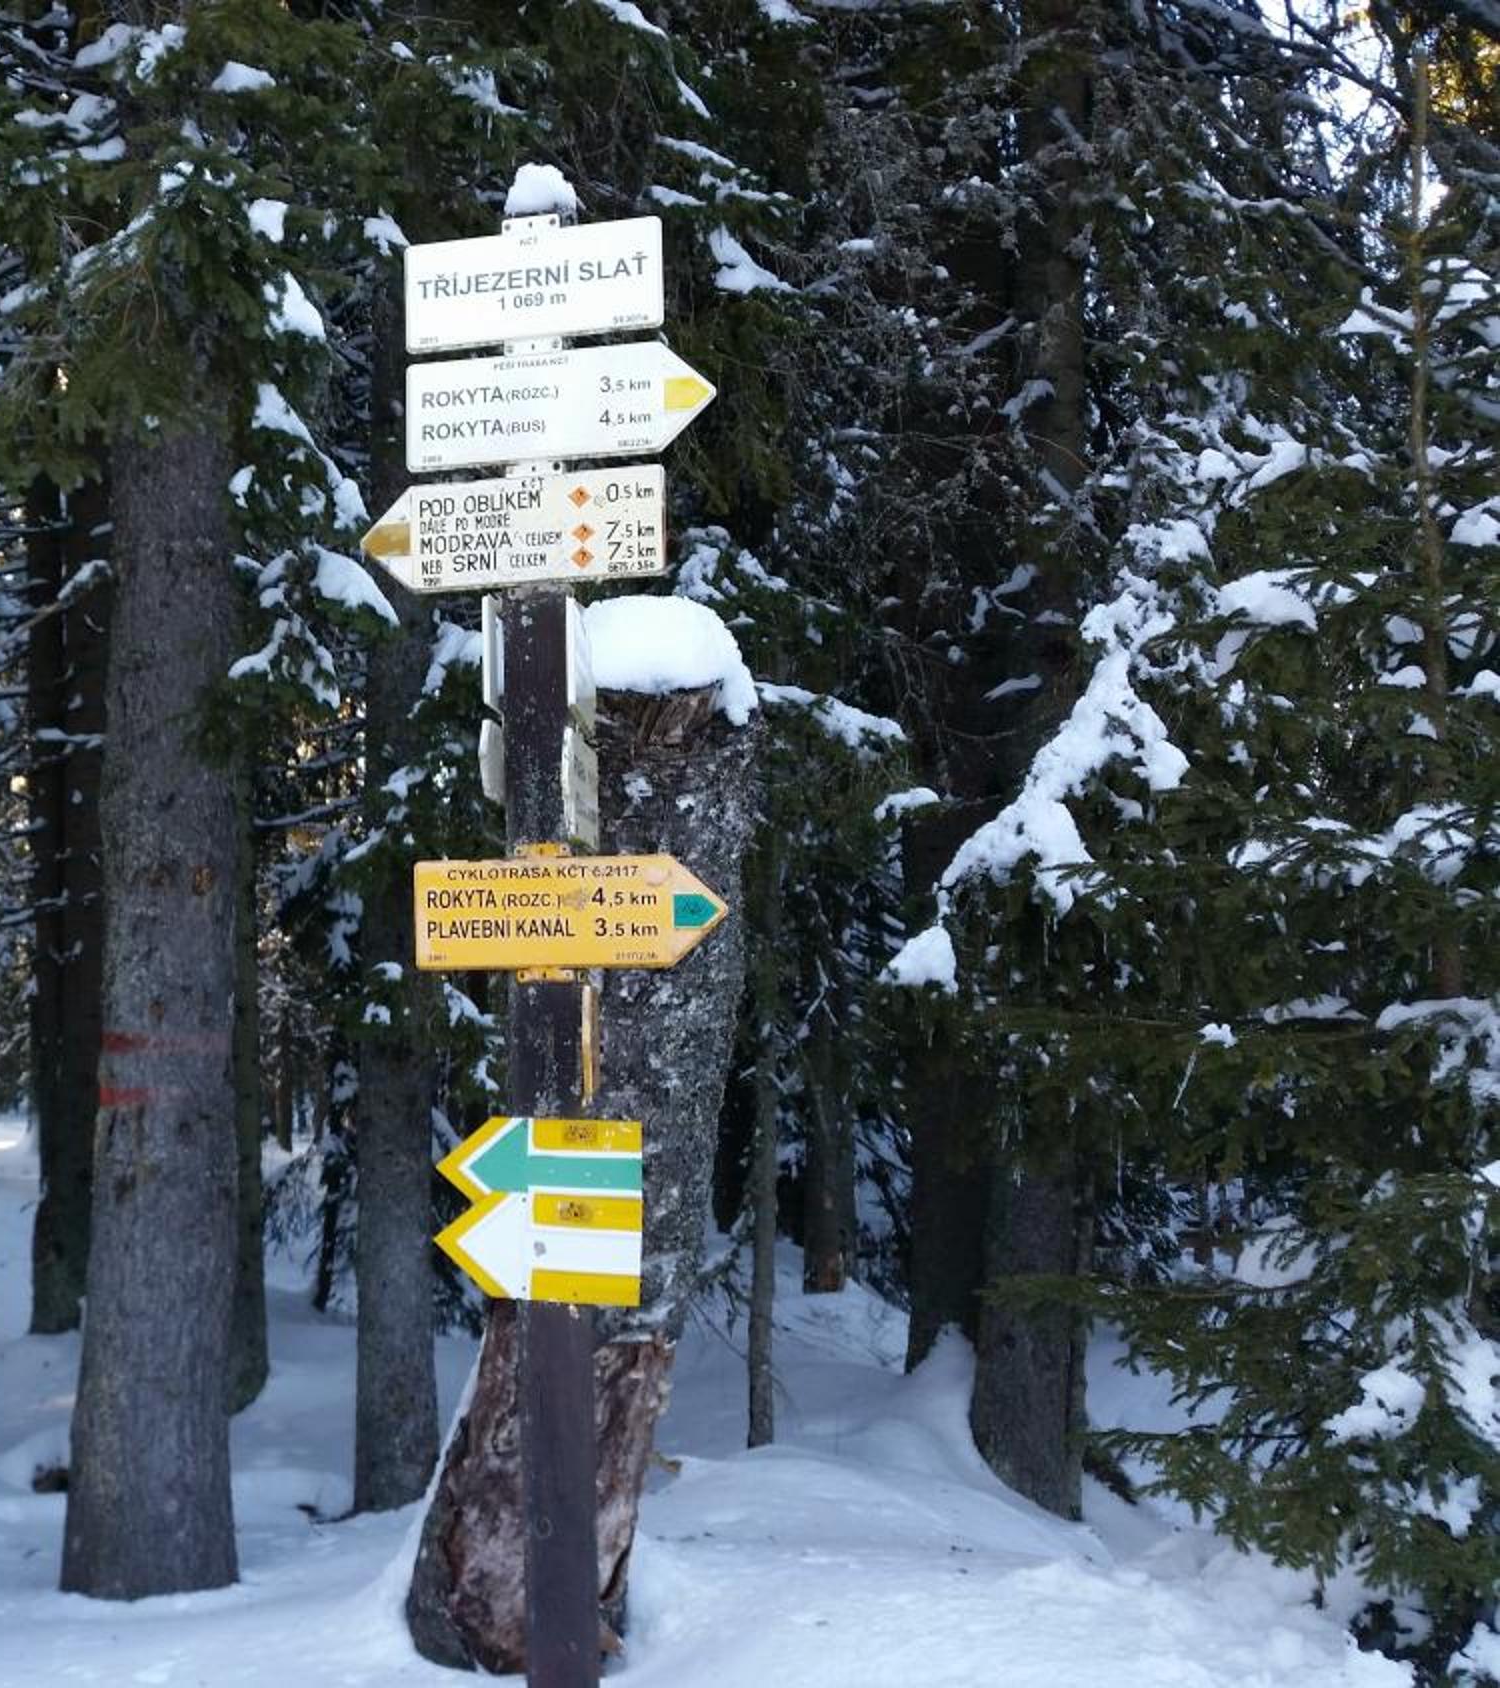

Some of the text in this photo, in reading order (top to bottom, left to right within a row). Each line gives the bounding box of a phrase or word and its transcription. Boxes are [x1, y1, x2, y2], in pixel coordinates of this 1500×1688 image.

[417, 251, 648, 300] TŘÍJEZERNÍ SLAŤ
[512, 291, 545, 310] 069
[549, 292, 567, 306] m
[421, 386, 504, 409] ROKYTA
[599, 375, 626, 394] 3,5
[628, 378, 652, 391] km
[421, 408, 652, 441] ROKYTA (BUS) 4,5 km
[419, 497, 456, 519] POD
[635, 481, 655, 498] km
[420, 530, 513, 555] MODRAVA
[525, 531, 563, 548] CELKEM
[637, 519, 656, 538] km
[455, 516, 469, 532] PO
[421, 558, 444, 576] NEB
[509, 552, 548, 569] CELKEM
[637, 541, 657, 558] km
[447, 866, 551, 882] CYKLOTRASA
[557, 863, 588, 878] KČT
[427, 889, 497, 910] ROKYTA
[591, 886, 625, 908] 4,5
[630, 892, 658, 906] km
[427, 915, 511, 940] PLAVEBNÍ
[516, 914, 576, 939] KANÁL
[631, 922, 659, 937] km
